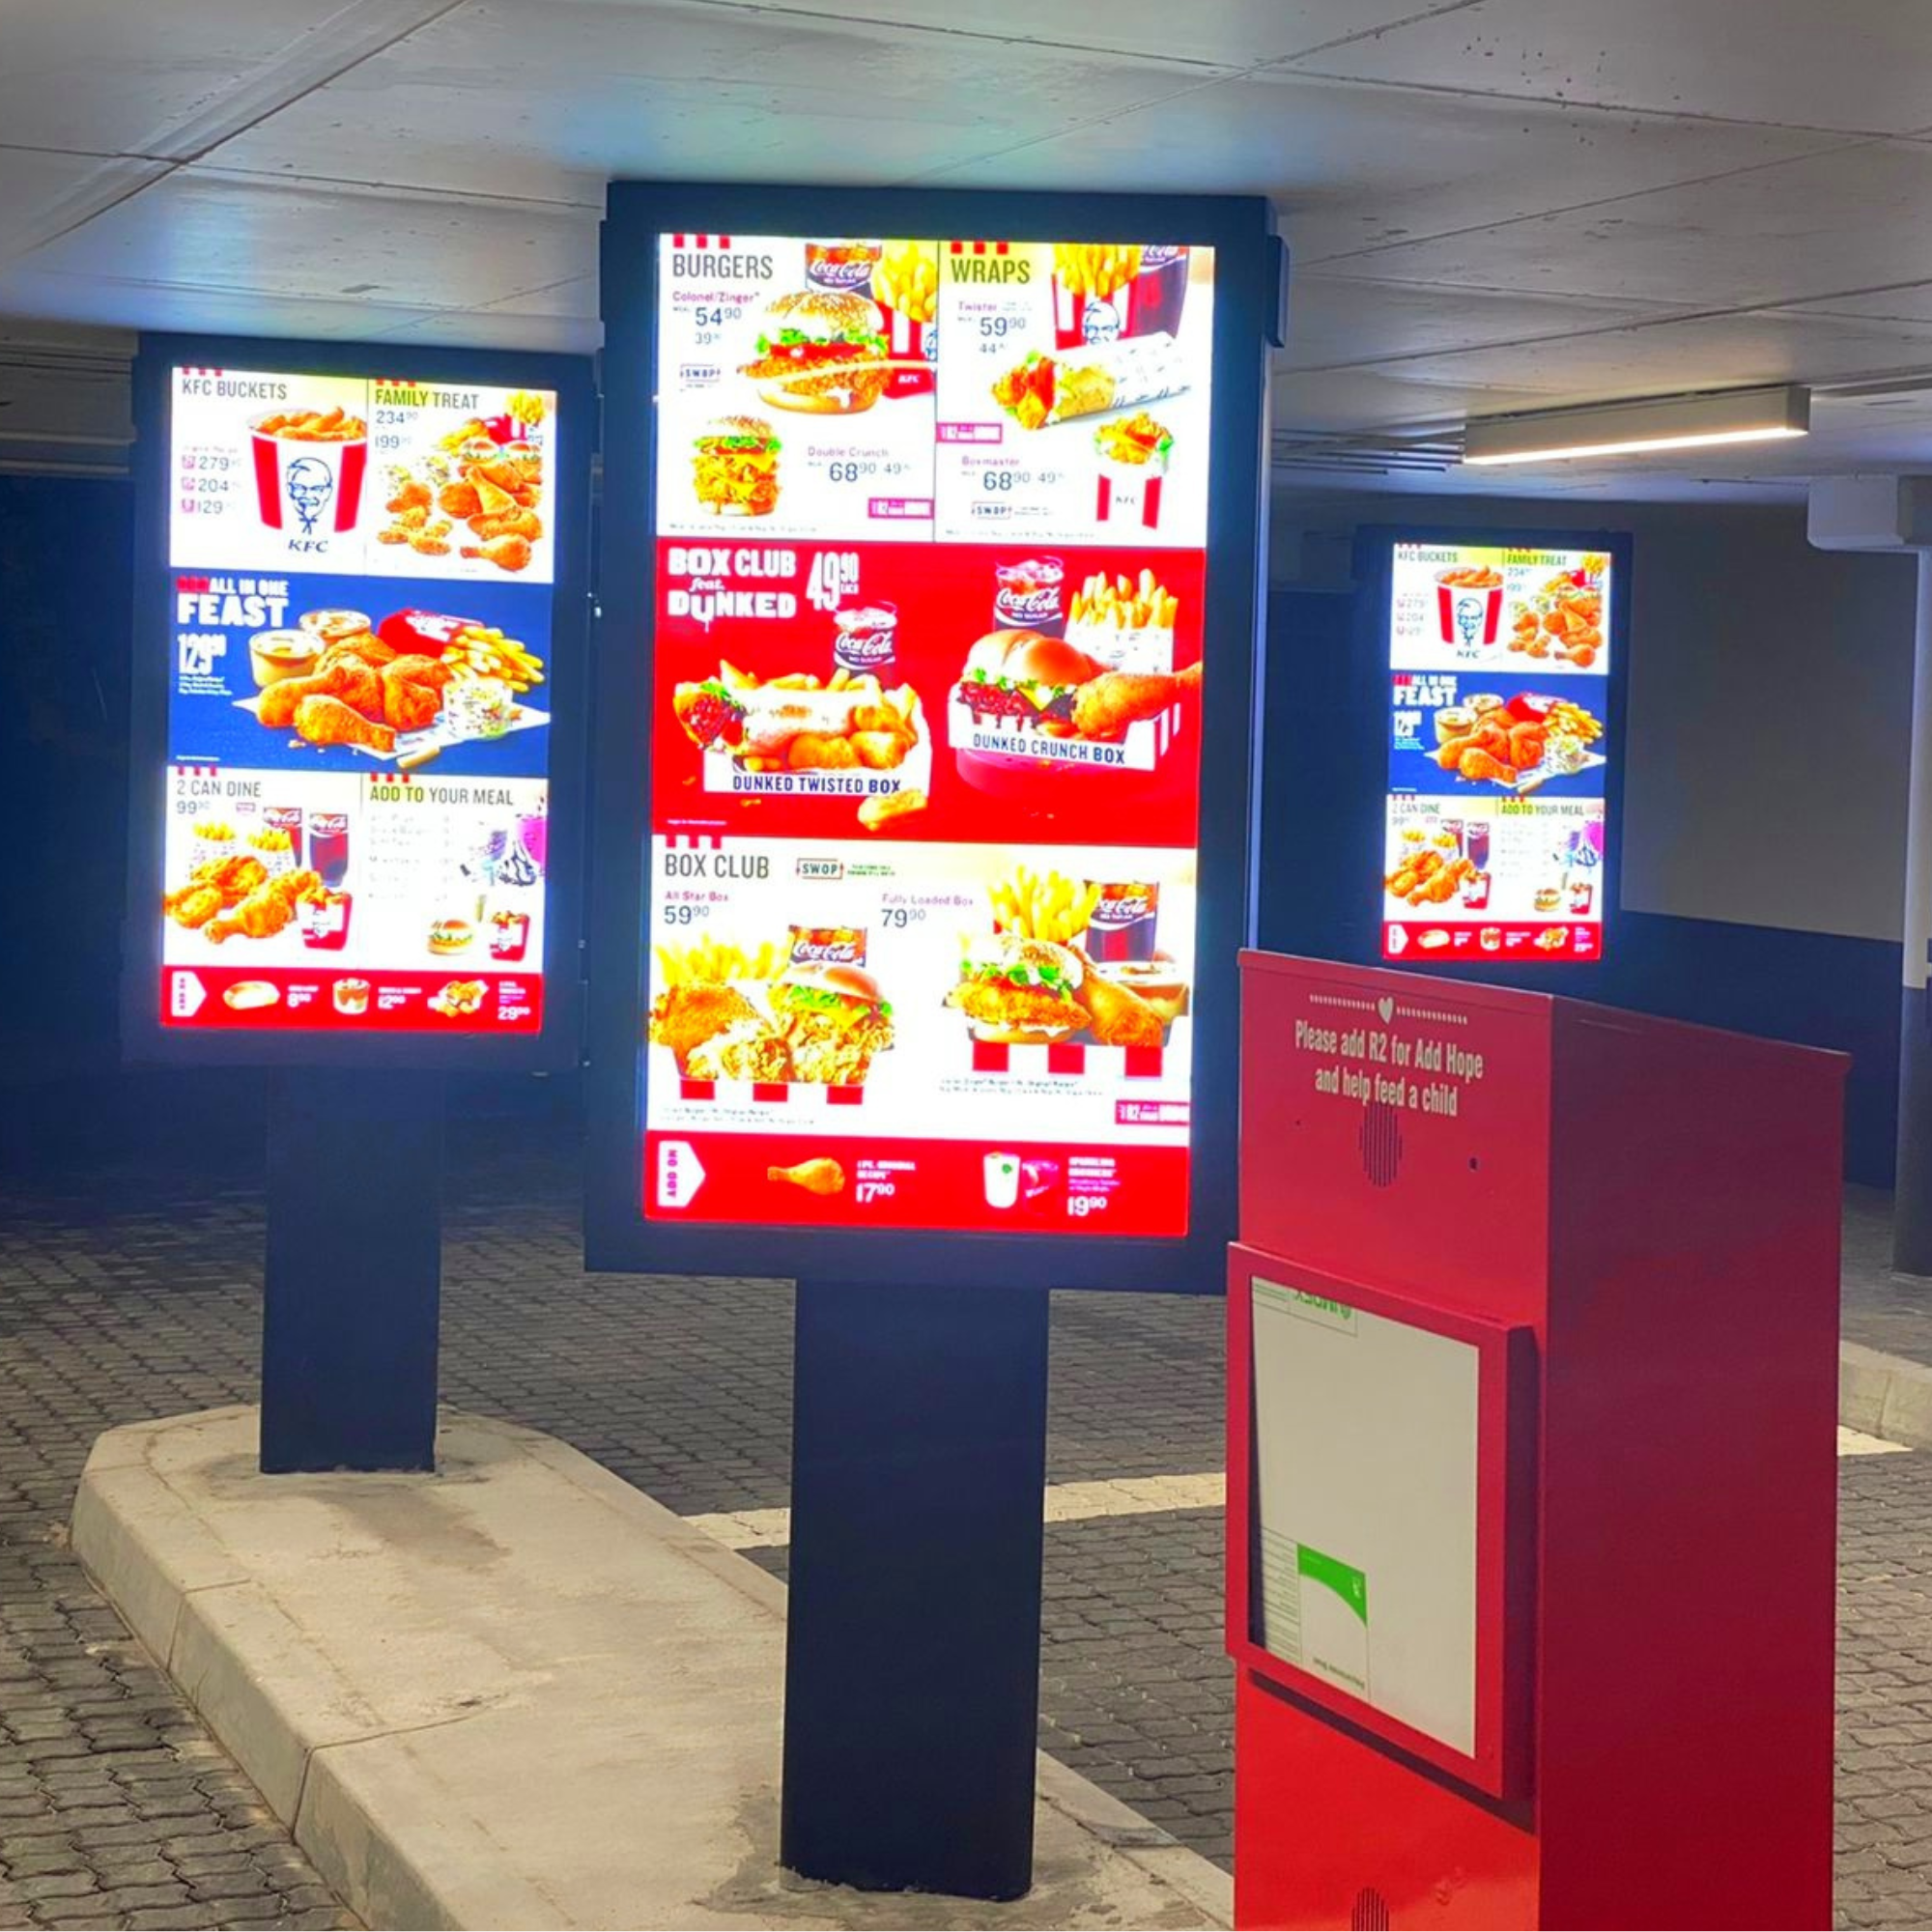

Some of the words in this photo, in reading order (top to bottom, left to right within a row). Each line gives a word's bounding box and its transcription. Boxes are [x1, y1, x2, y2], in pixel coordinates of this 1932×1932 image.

[672, 253, 774, 279] BURGERS
[951, 259, 1031, 284] WRAPS
[182, 380, 213, 395] KFC
[216, 381, 288, 400] BUCKETS
[375, 389, 429, 407] FAMILY
[433, 392, 480, 410] TREAT
[808, 446, 845, 457] Double
[848, 446, 889, 458] Crunch
[288, 539, 328, 553] KFC
[668, 548, 731, 577] BOX
[734, 549, 796, 578] CLUB
[209, 577, 237, 593] ALL
[178, 593, 289, 627] FEAST
[668, 590, 797, 625] DUNKED
[1393, 686, 1458, 706] FEAST
[973, 733, 1027, 753] DUNKED
[1031, 740, 1089, 760] CRUNCH
[1093, 748, 1125, 764] BOX
[177, 780, 186, 796] 2
[190, 780, 221, 796] CAN
[226, 781, 262, 798] DINE
[732, 775, 793, 792] DUNKED
[799, 777, 864, 793] TWISTED
[869, 779, 901, 794] BOX
[370, 785, 401, 802] ADD
[405, 786, 425, 803] TO
[429, 787, 469, 805] YOUR
[472, 788, 514, 806] MEAL
[665, 853, 708, 877] BOX
[714, 855, 770, 879] CLUB
[802, 863, 838, 875] SWOP
[682, 891, 706, 901] Star
[1295, 1020, 1337, 1054] Please
[1341, 1029, 1365, 1059] add
[1369, 1032, 1387, 1063] R2
[1391, 1036, 1411, 1066] for
[1414, 1039, 1441, 1072] Add
[1446, 1043, 1483, 1084] Hope
[1315, 1066, 1339, 1094] and
[1343, 1067, 1370, 1106] help
[1375, 1073, 1405, 1106] feed
[1408, 1085, 1418, 1109] a
[1422, 1083, 1458, 1117] child
